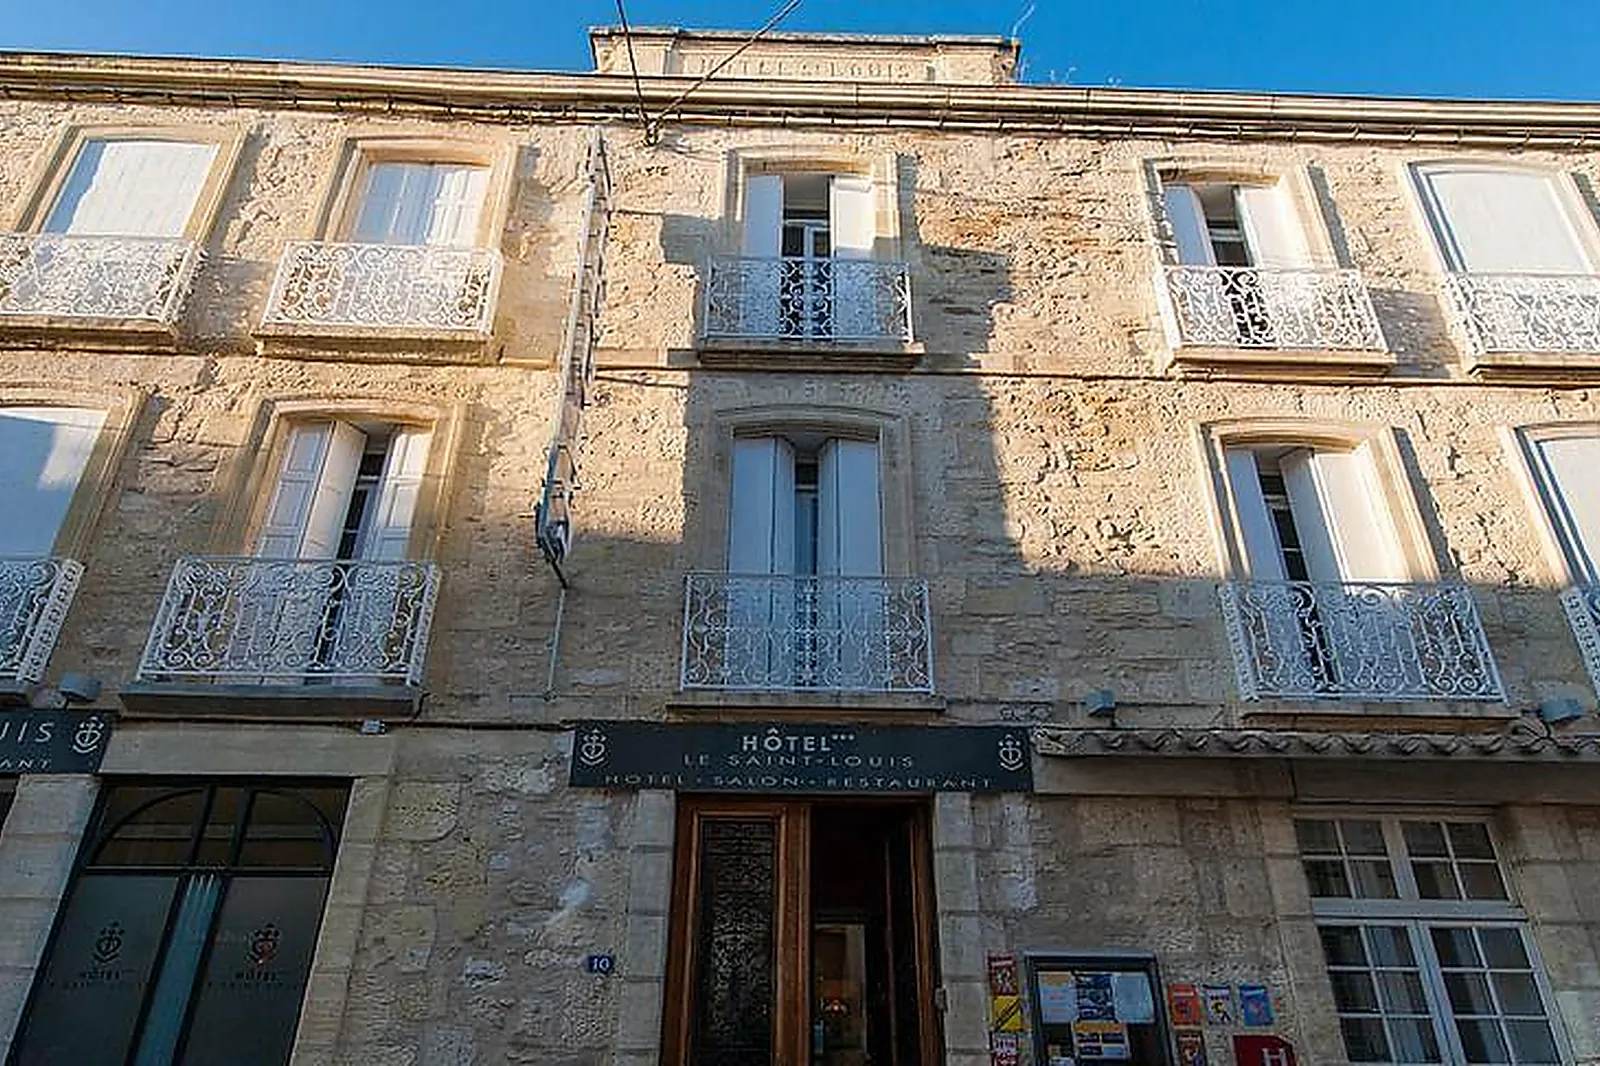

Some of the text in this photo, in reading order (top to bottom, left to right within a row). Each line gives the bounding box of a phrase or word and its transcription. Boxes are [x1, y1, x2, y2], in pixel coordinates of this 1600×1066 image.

[742, 727, 832, 752] HÔTEL
[683, 753, 914, 768] LE SAINT-LOUIS
[826, 776, 992, 789] RESTAURANT
[593, 957, 610, 971] 10
